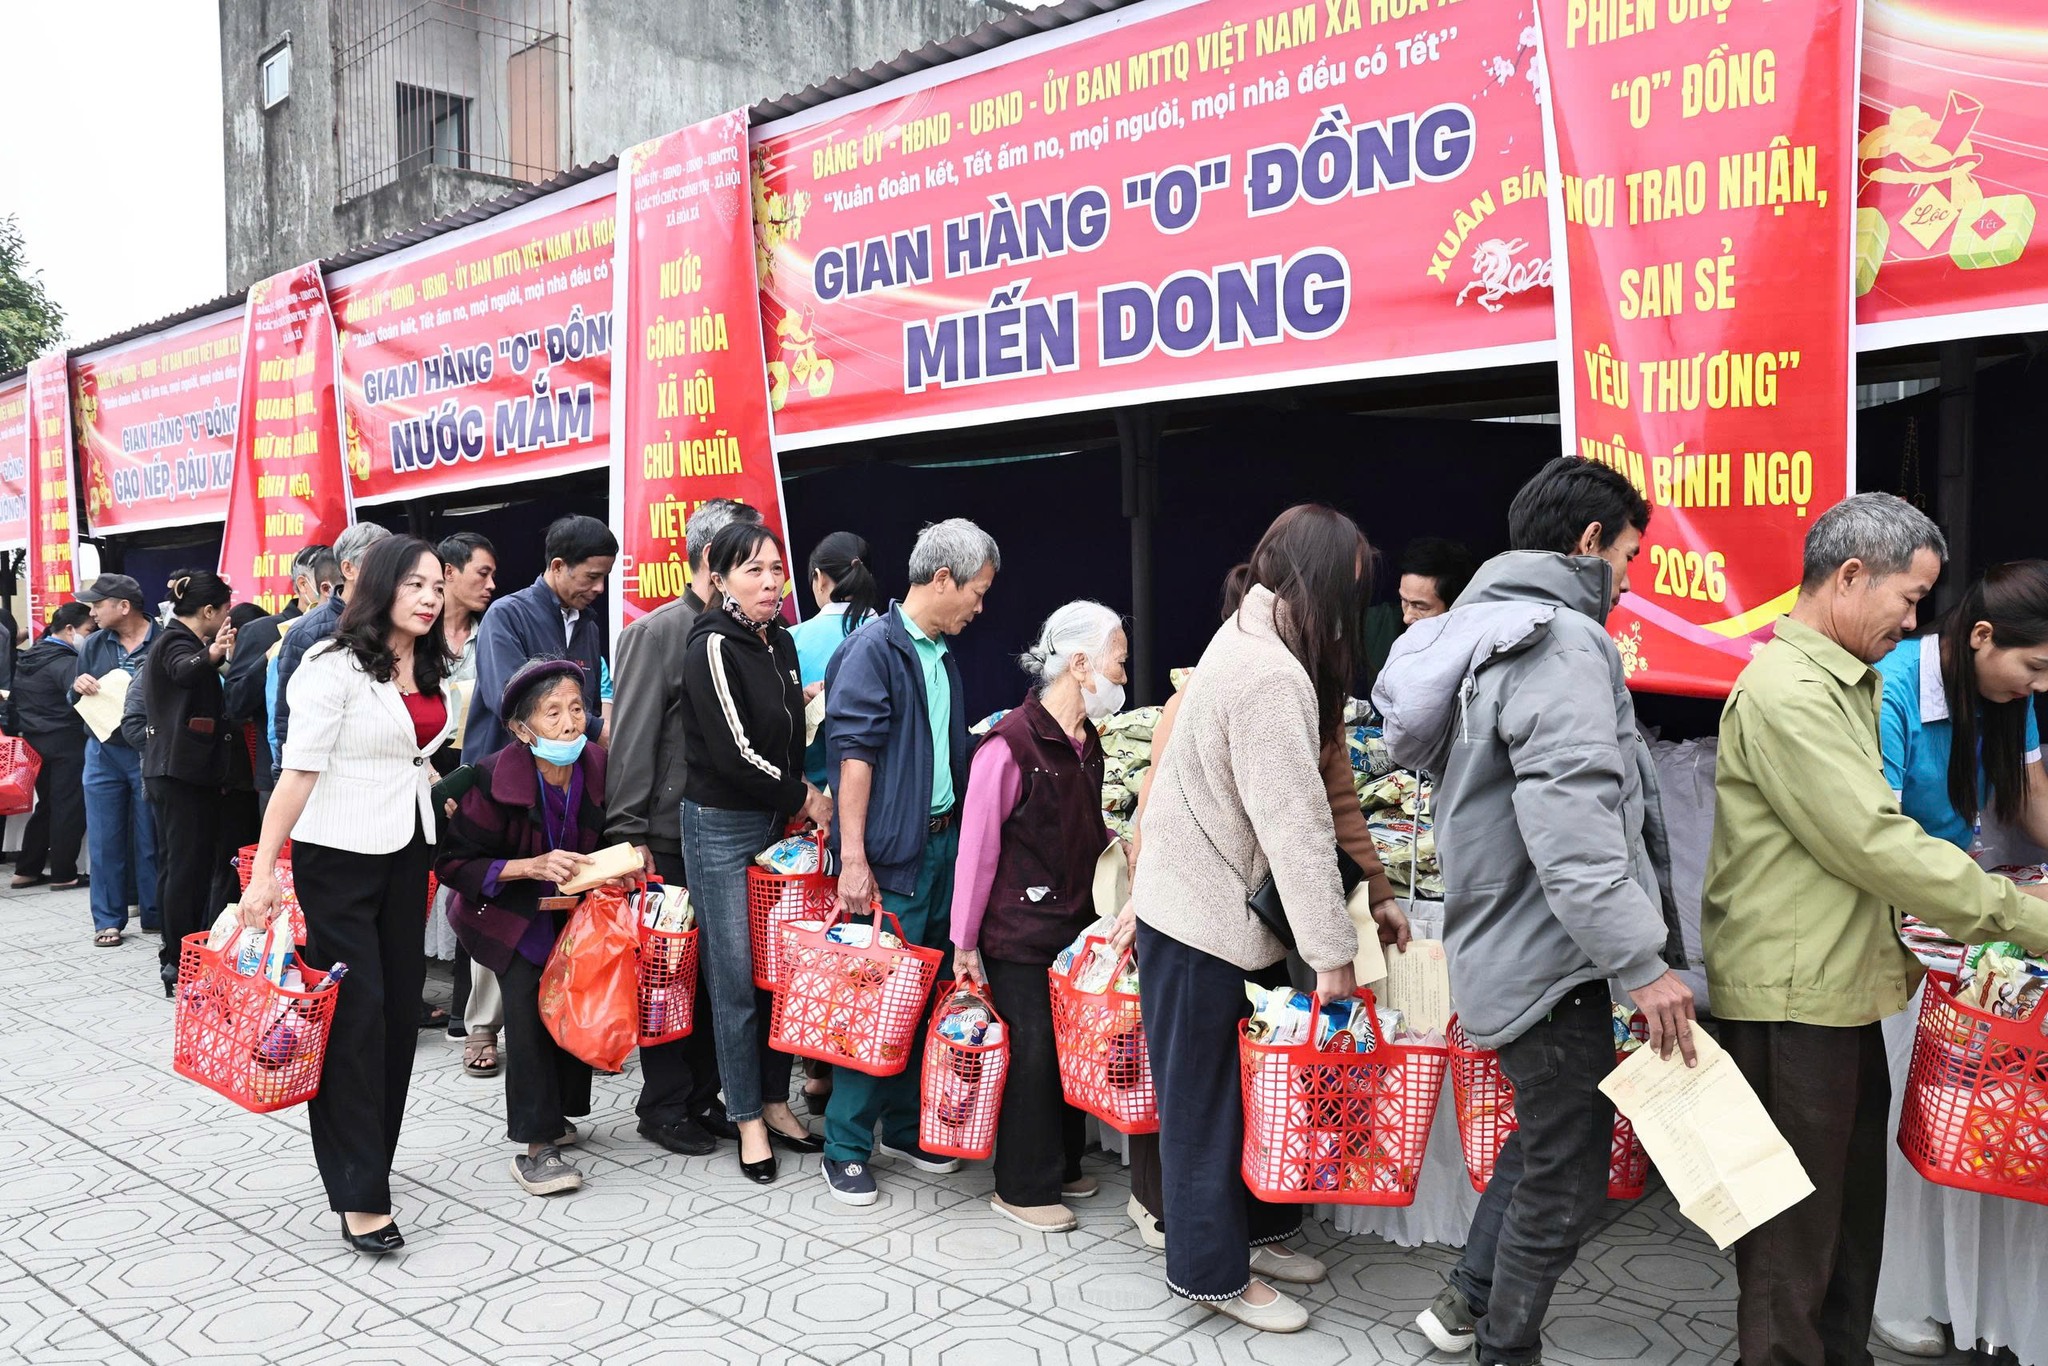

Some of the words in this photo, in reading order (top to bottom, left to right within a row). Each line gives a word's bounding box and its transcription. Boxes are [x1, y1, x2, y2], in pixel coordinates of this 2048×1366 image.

[812, 137, 858, 180] ĐẢNG
[862, 124, 884, 166] ỦY
[900, 112, 950, 155] HĐND
[969, 90, 1023, 136] UBND
[1043, 69, 1070, 115] ỦY
[1076, 61, 1121, 107] BAN
[1128, 41, 1189, 90] MTTQ
[1197, 20, 1248, 75] VIỆT
[1256, 8, 1316, 57] NAM
[1682, 43, 1776, 119] ĐỒNG
[878, 172, 921, 202] đoàn
[925, 160, 959, 187] kết,
[963, 148, 992, 178] Tết
[997, 139, 1028, 168] ấm
[1034, 137, 1064, 160] no,
[1070, 117, 1109, 152] mọi
[1115, 104, 1185, 142] người,
[1191, 84, 1236, 122] mọi
[1243, 70, 1290, 108] nhà
[1297, 55, 1346, 95] đều
[1354, 45, 1388, 79] có
[726, 168, 741, 189] HỘI
[812, 228, 932, 301] GIAN
[943, 187, 1109, 277] HÀNG
[1245, 105, 1477, 219] ĐỒNG
[1625, 160, 1706, 226] TRAO
[1719, 135, 1828, 216] NHẬN,
[1427, 189, 1496, 284] XUÂN
[1911, 204, 1950, 226] Lộc
[1980, 218, 1997, 229] Tết
[421, 272, 448, 301] UBND
[455, 260, 468, 291] ỦY
[470, 257, 492, 287] BAN
[493, 248, 521, 279] MTTQ
[521, 237, 544, 273] VIỆT
[546, 230, 573, 263] NAM
[574, 220, 591, 254] XÃ
[469, 294, 489, 317] mọi
[524, 278, 544, 302] mọi
[547, 271, 567, 295] nhà
[570, 264, 591, 288] đều
[594, 259, 608, 281] có
[659, 248, 702, 299] NƯỚC
[1619, 261, 1683, 320] SAN
[1694, 236, 1736, 311] SẺ
[646, 315, 686, 367] CỘNG
[689, 306, 729, 354] HÒA
[903, 283, 1081, 395] MIẾN
[1097, 245, 1352, 367] DONG
[260, 355, 294, 382] MỪNG
[362, 361, 419, 407] GIAN
[423, 344, 492, 393] HÀNG
[545, 303, 613, 365] ĐỒN
[1583, 343, 1629, 410] YÊU
[1639, 349, 1800, 413] THƯƠNG”
[255, 396, 294, 421] QUANG
[389, 396, 485, 474] NƯỚC
[493, 372, 594, 457] MẮM
[657, 377, 679, 419] XÃ
[683, 369, 716, 426] HỘI
[122, 423, 147, 454] GIAN
[149, 413, 184, 450] HÀNG
[253, 432, 292, 460] MỪNG
[643, 430, 675, 480] CHỦ
[679, 429, 743, 478] NGHĨA
[113, 466, 140, 508] GẠO
[142, 451, 175, 502] NẾP,
[175, 448, 207, 499] ĐẬU
[258, 471, 286, 498] BÍNH
[289, 472, 315, 500] NGỌ,
[1652, 441, 1730, 507] BÍNH
[1743, 451, 1812, 516] NGỌ
[265, 509, 304, 537] MỪNG
[649, 493, 687, 546] VIỆT
[253, 550, 276, 578] ĐẤT
[1650, 544, 1726, 603] 2026
